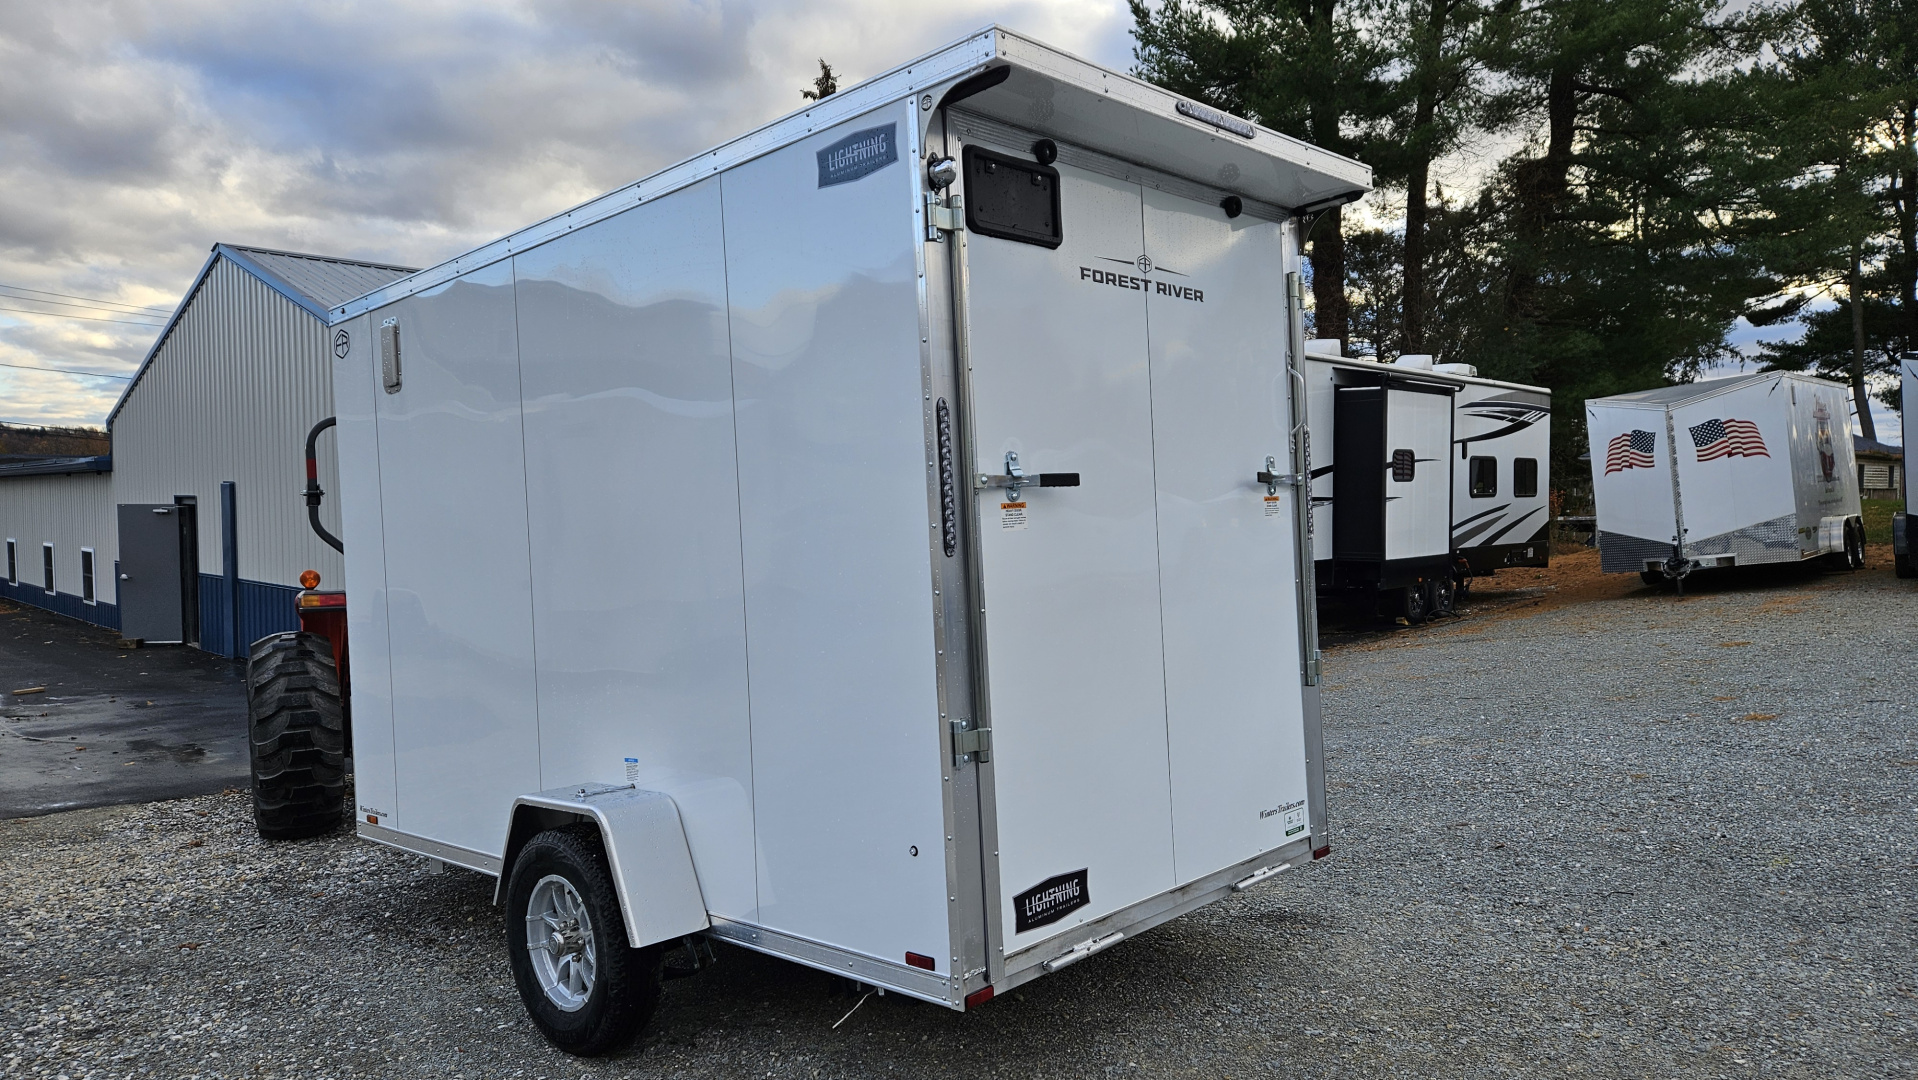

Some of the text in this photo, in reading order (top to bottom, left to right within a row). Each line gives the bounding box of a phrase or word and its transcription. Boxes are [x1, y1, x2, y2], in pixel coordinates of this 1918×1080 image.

[828, 133, 887, 172] LIGHTNING
[1079, 266, 1204, 303] FOREST RIVER
[1025, 878, 1081, 917] LIGHTNING
